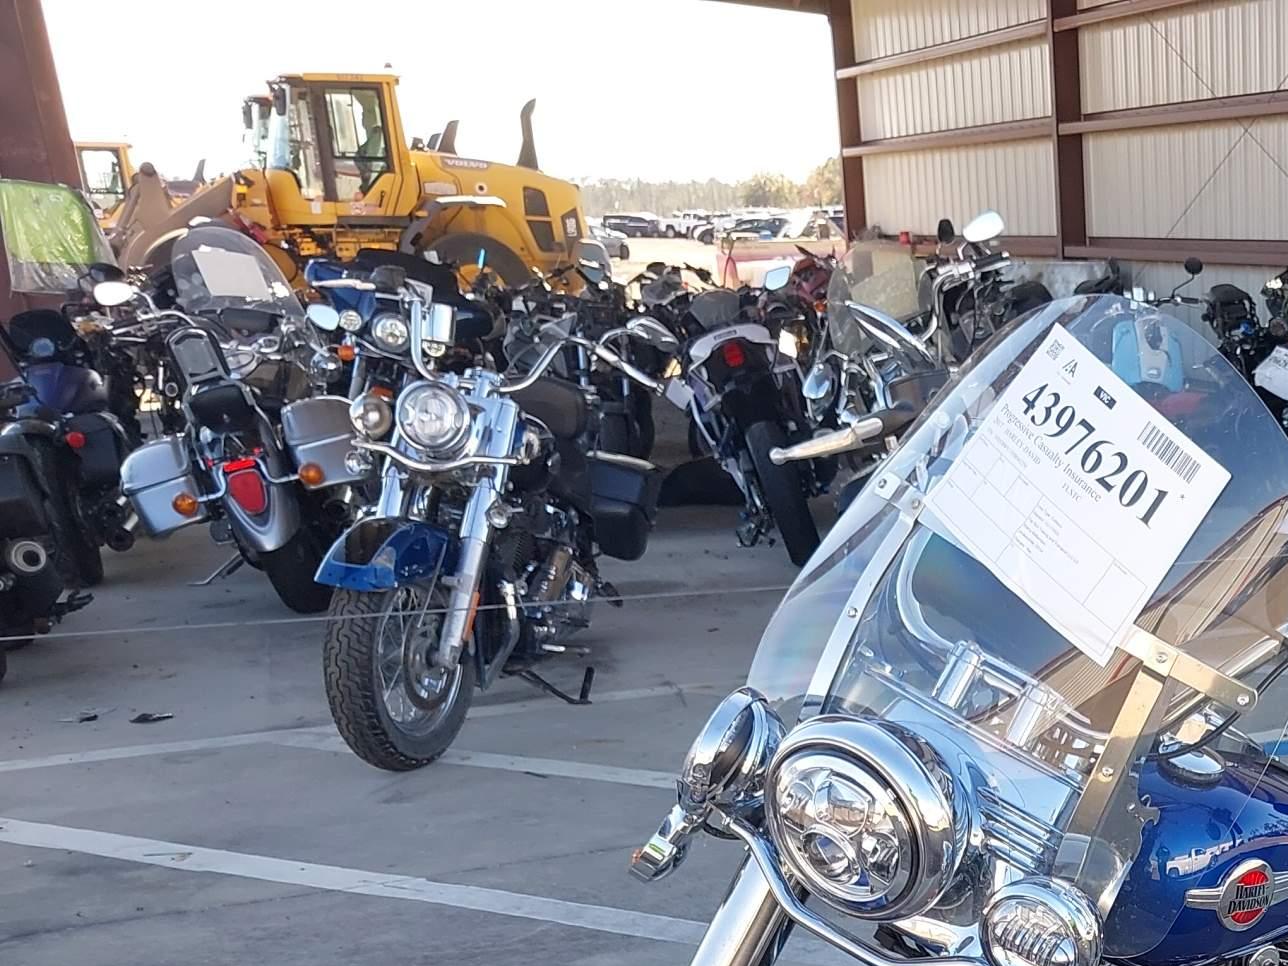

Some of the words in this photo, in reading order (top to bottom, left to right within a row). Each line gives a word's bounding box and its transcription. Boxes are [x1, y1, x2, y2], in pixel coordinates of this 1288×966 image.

[1000, 403, 1035, 440] Progressive
[1033, 435, 1065, 469] Casualty
[1063, 463, 1102, 503] Insurance
[1022, 383, 1169, 530] 43976201
[1228, 895, 1269, 915] DAVIDSON
